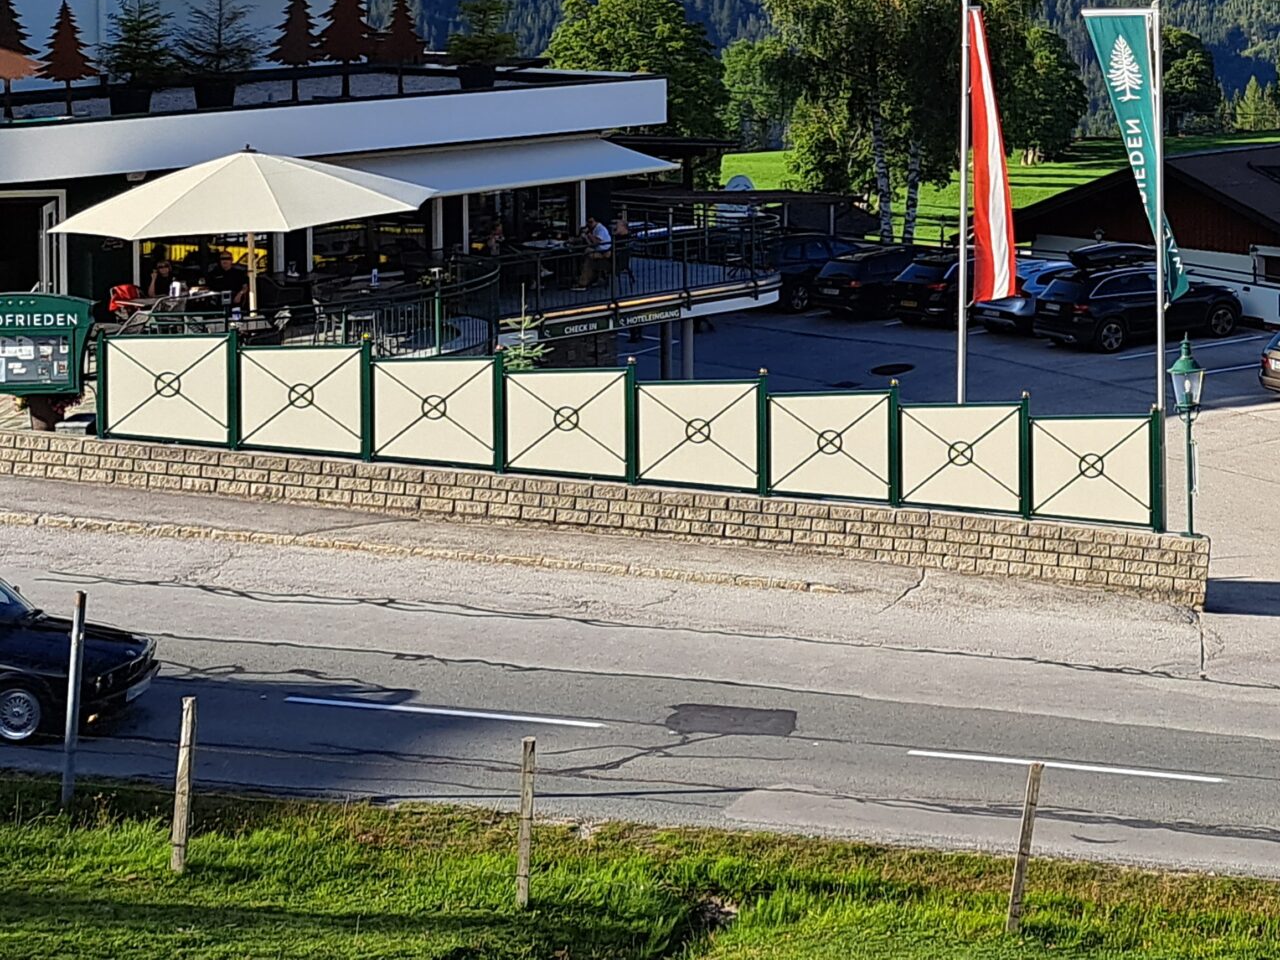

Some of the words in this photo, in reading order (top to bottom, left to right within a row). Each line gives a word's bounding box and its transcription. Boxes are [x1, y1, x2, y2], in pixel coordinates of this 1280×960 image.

[626, 309, 680, 325] HOTELEINGANG
[564, 323, 588, 335] CHECK
[588, 322, 598, 331] IN
